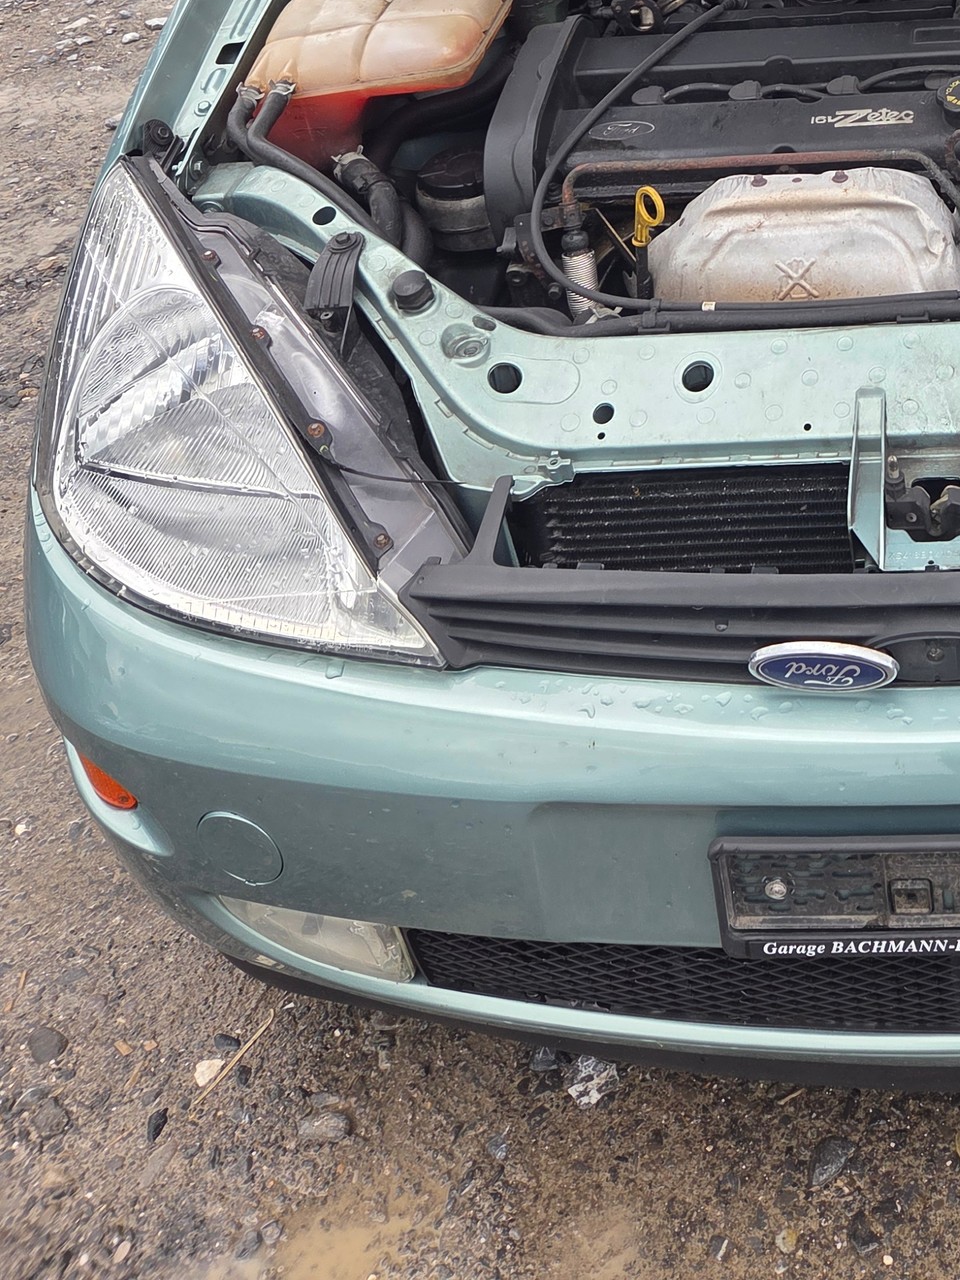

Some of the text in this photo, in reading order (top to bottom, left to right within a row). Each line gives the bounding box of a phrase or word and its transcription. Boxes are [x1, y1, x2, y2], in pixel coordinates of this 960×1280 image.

[834, 108, 914, 127] Zetec
[784, 661, 861, 686] Ford
[763, 942, 826, 956] Garage
